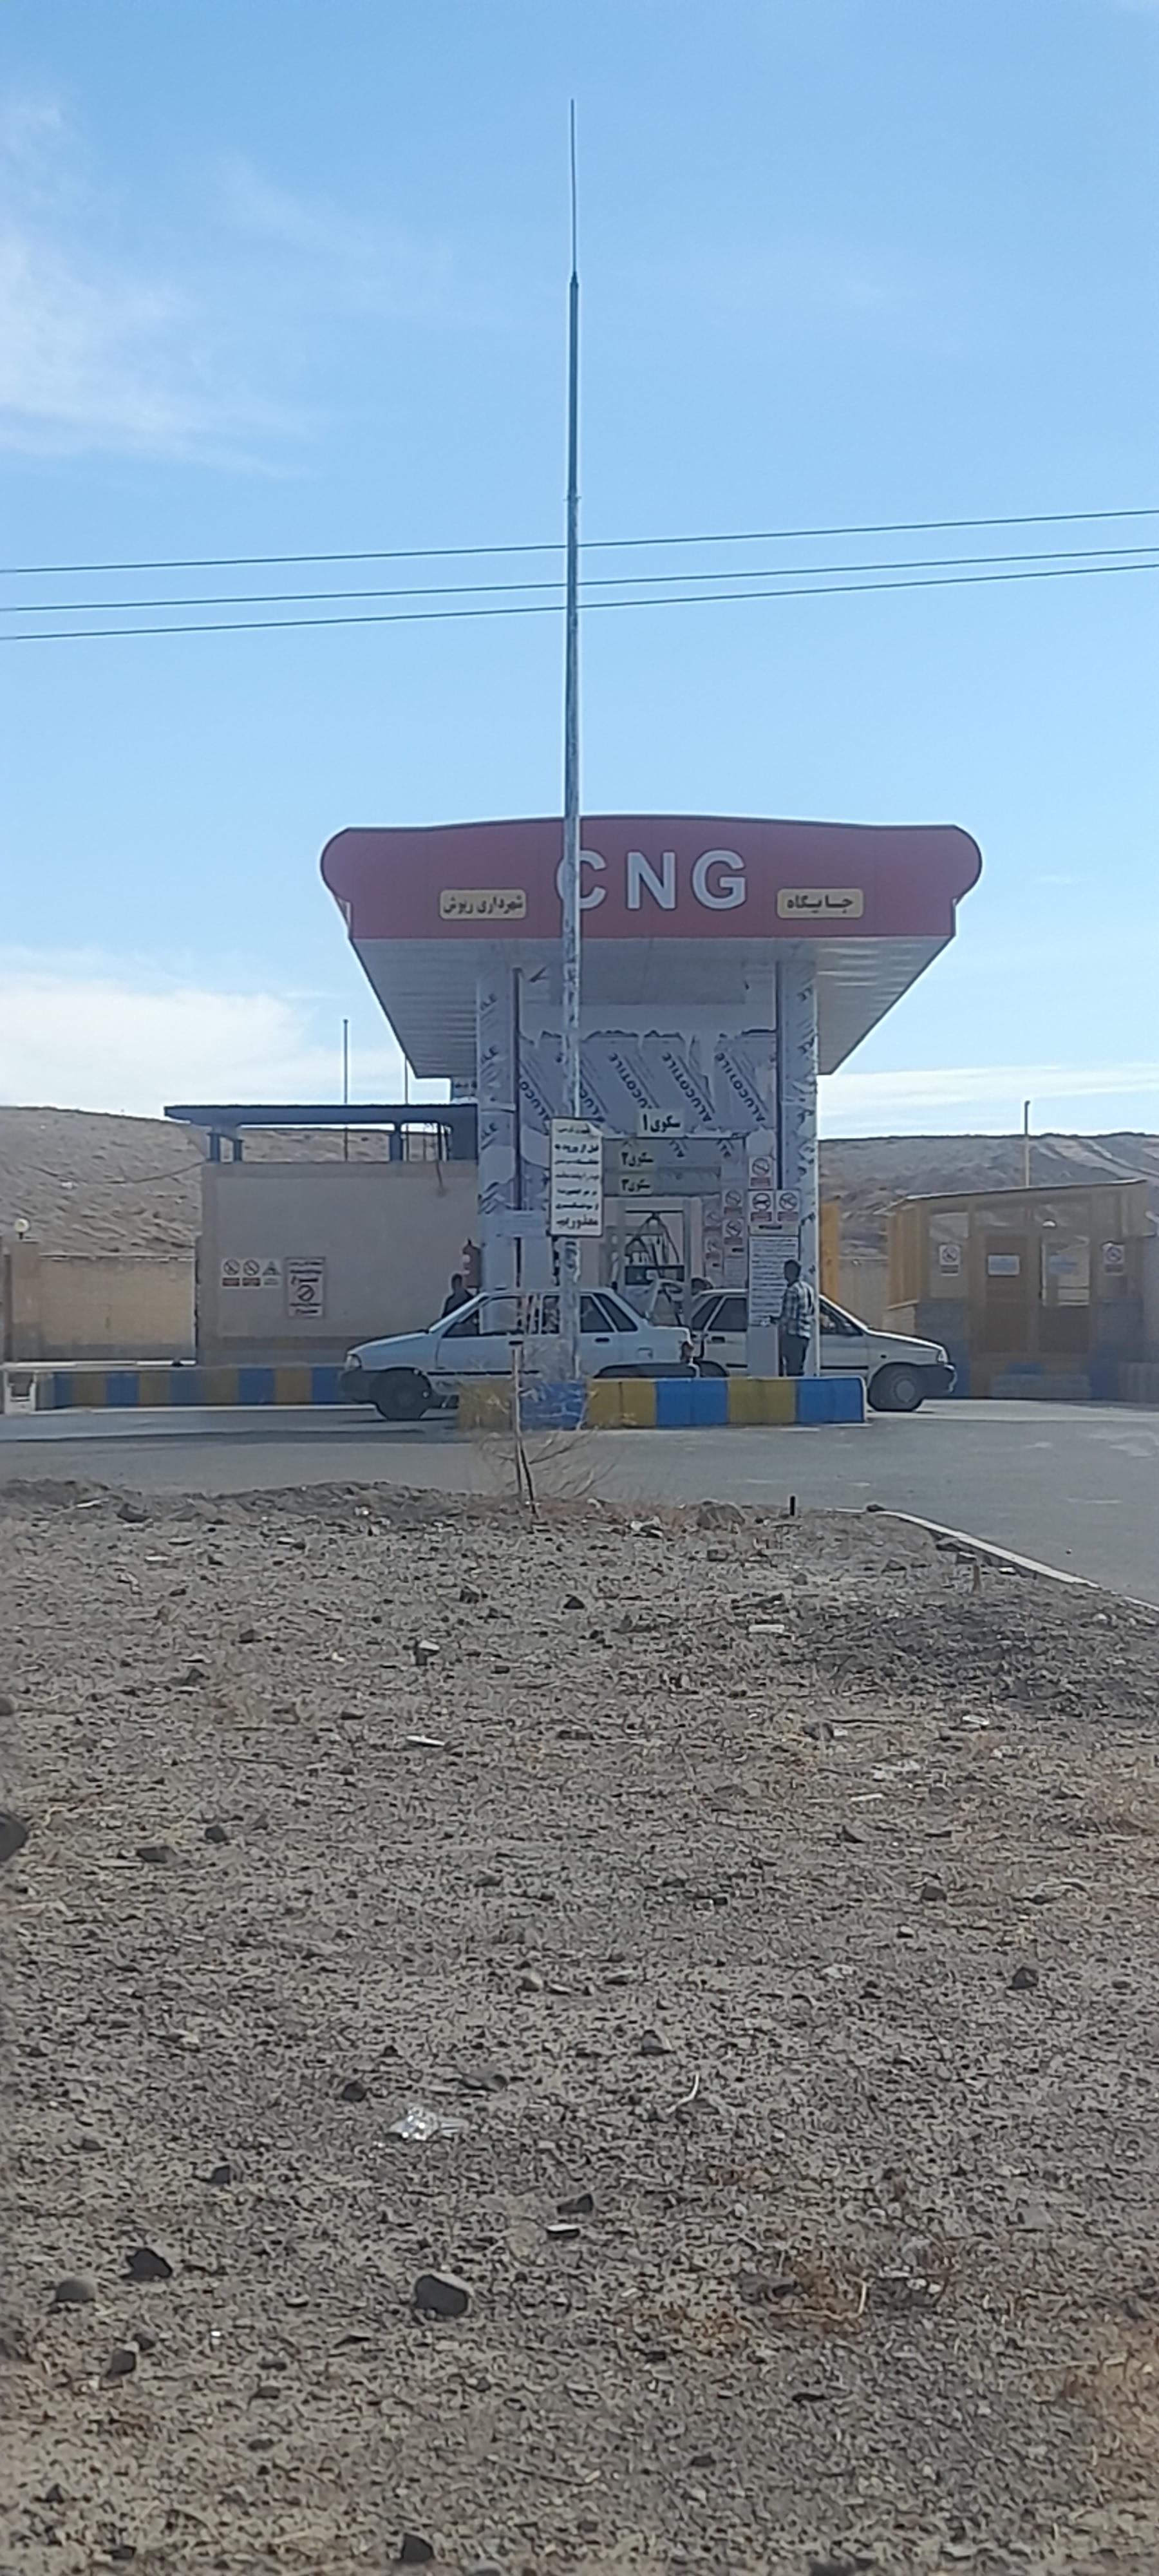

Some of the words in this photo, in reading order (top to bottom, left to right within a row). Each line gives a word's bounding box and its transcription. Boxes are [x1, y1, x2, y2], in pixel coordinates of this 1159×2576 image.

[476, 895, 523, 914] شهرداری
[556, 849, 746, 910] CNG
[786, 894, 853, 914] جایگاه
[519, 1081, 551, 1122] ALUCO
[609, 1052, 653, 1109] UCOTILE
[662, 1052, 712, 1122] ALUCOTILE
[714, 1052, 766, 1122] ALUCOTILE
